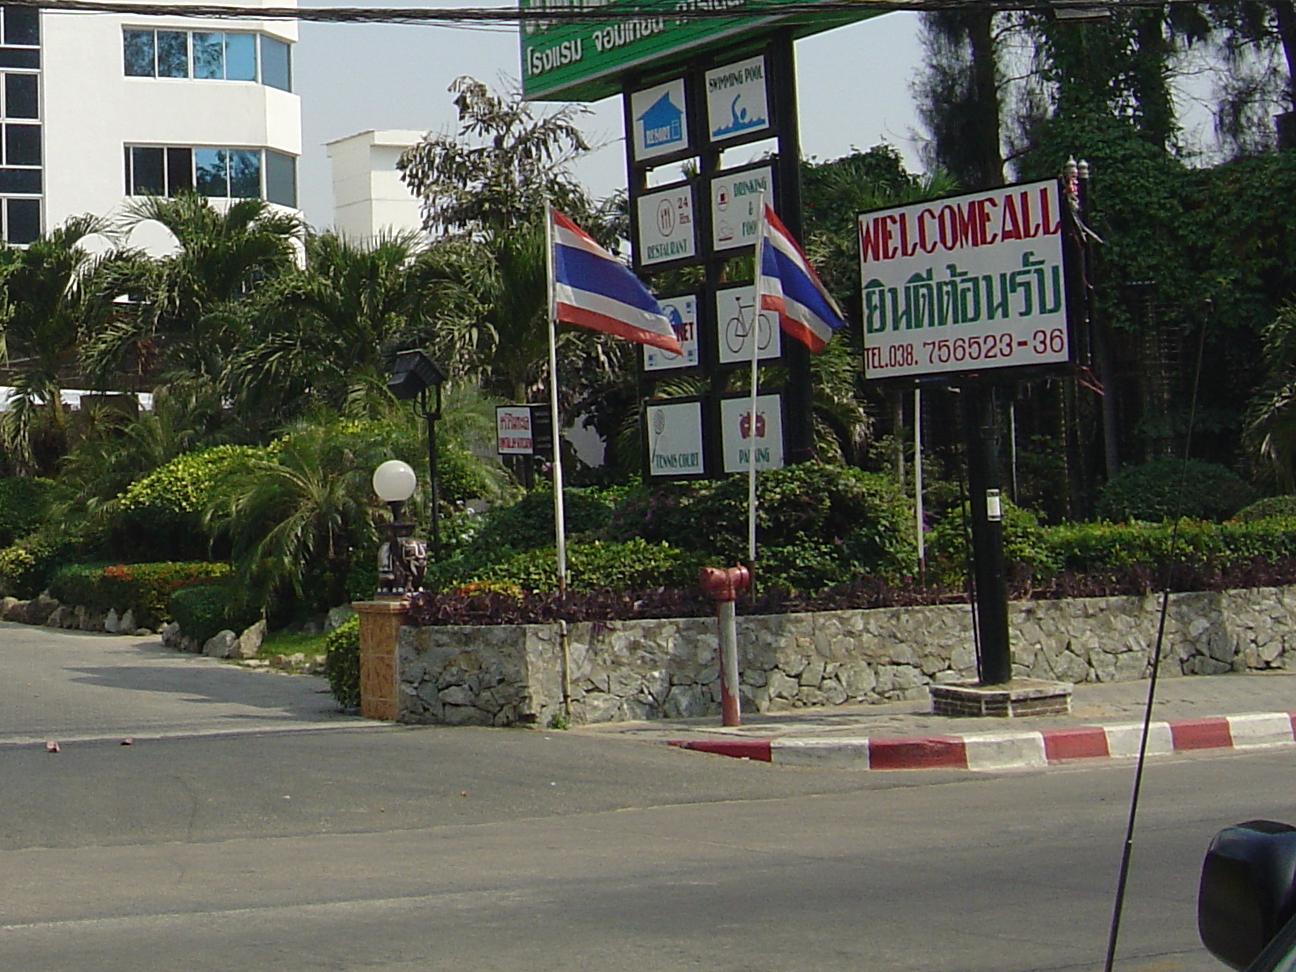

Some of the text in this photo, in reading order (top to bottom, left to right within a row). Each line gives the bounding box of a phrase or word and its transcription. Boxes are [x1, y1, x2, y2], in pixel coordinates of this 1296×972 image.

[527, 38, 582, 75] โรงแรม
[744, 64, 764, 83] POOL
[677, 196, 689, 209] 24
[647, 238, 687, 260] RESTAURANT
[863, 250, 1063, 335] ยินดีต้อนรับ
[923, 328, 1065, 364] 756523-36
[678, 451, 700, 469] COURT
